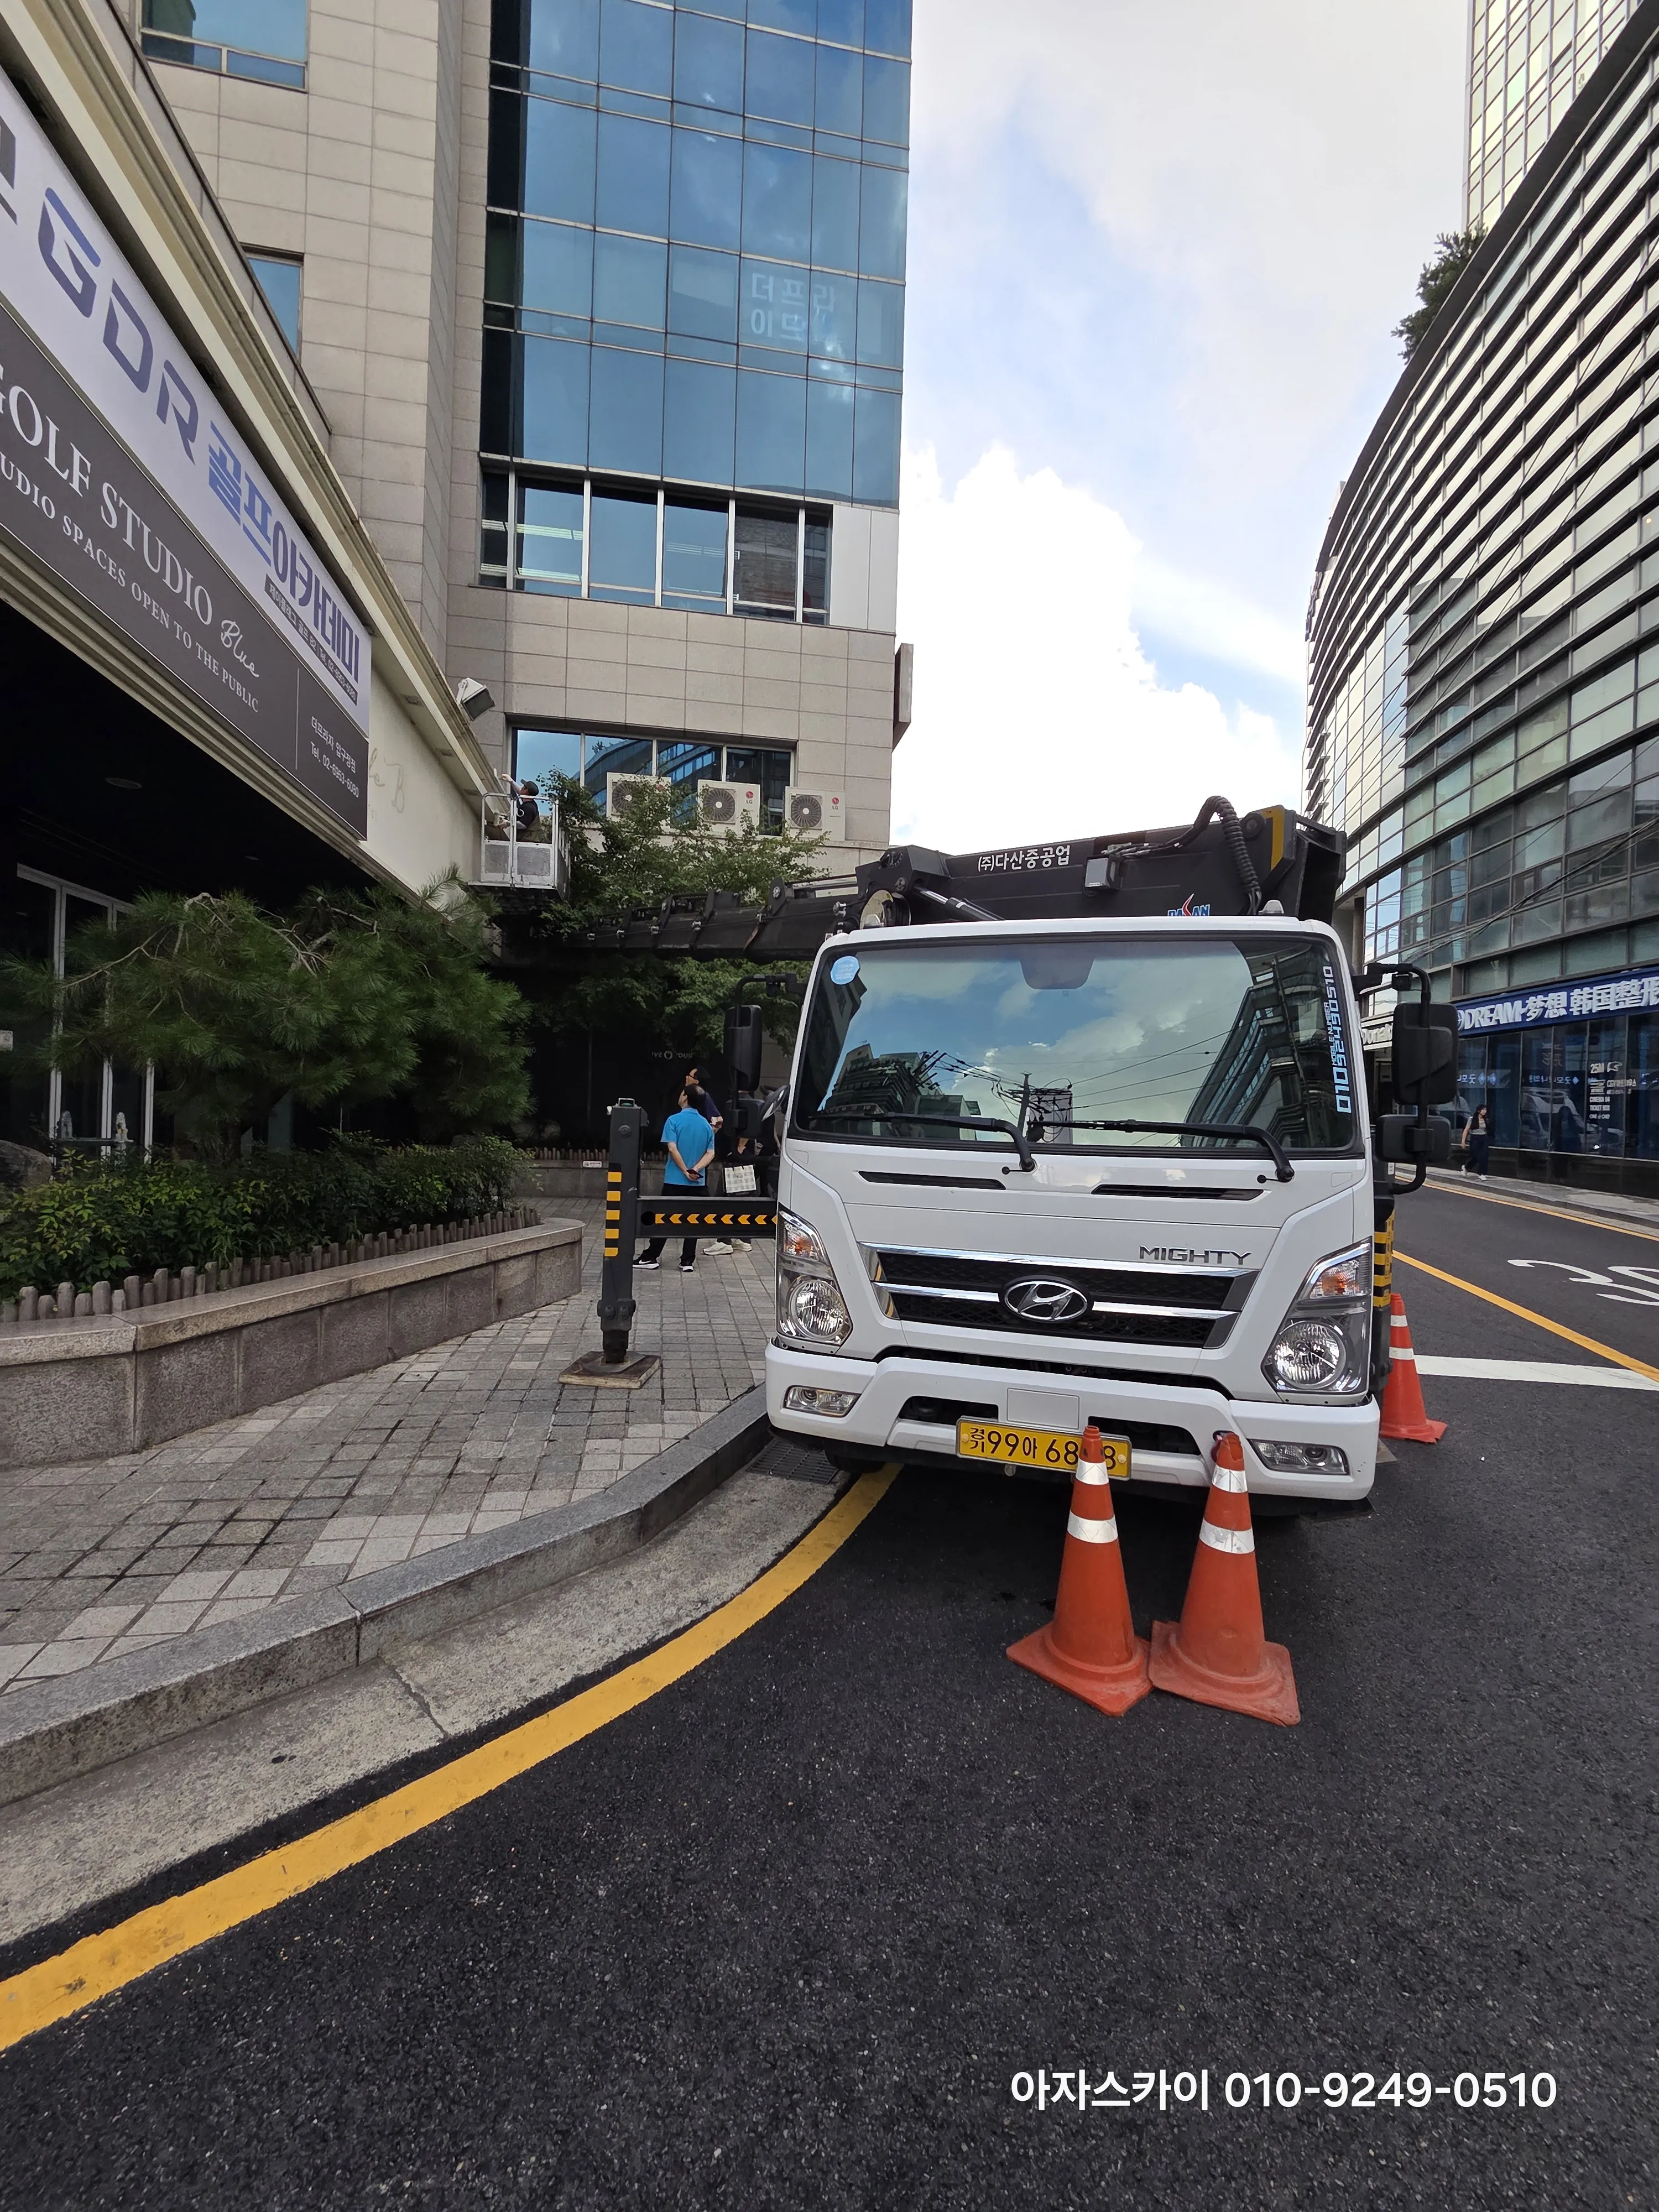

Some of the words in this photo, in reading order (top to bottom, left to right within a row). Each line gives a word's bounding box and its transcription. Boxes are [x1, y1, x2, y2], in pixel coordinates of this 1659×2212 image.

[38, 186, 200, 465] GDR
[101, 481, 213, 625] STUDIO
[221, 619, 259, 678] Blue
[62, 515, 126, 587] SPACES
[131, 581, 170, 630] OPEN
[173, 622, 192, 650] TO
[195, 643, 219, 676] THE
[222, 671, 259, 713] PUBLIC
[311, 716, 334, 751] 더프라자
[978, 845, 1071, 872] (주)다산중공업
[1323, 1001, 1334, 1035] NUMBER
[1464, 1000, 1522, 1030] DREAM
[1329, 1036, 1338, 1066] MOBILE
[1139, 1245, 1252, 1265] MIGHTY
[1045, 1438, 1117, 1470] 688
